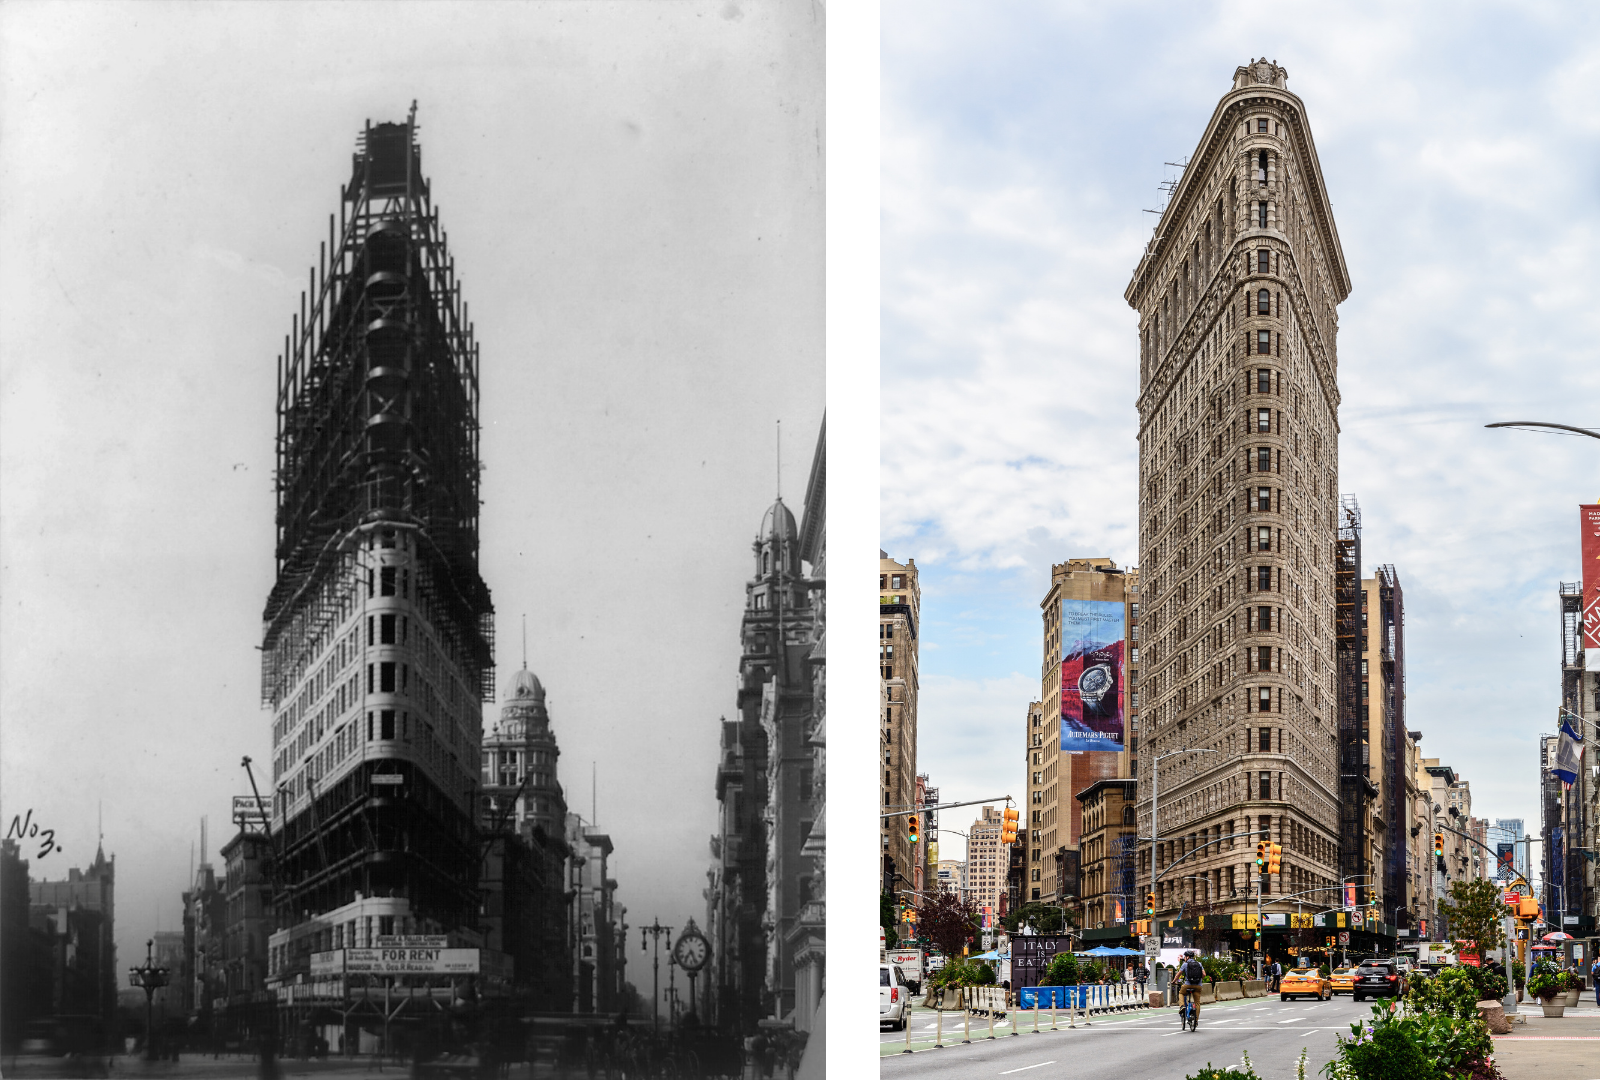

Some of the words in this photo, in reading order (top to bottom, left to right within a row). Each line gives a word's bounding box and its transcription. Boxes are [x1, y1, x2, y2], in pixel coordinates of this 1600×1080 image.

[1099, 731, 1119, 739] PIGUET
[382, 950, 406, 960] FOR
[410, 950, 441, 960] RENT
